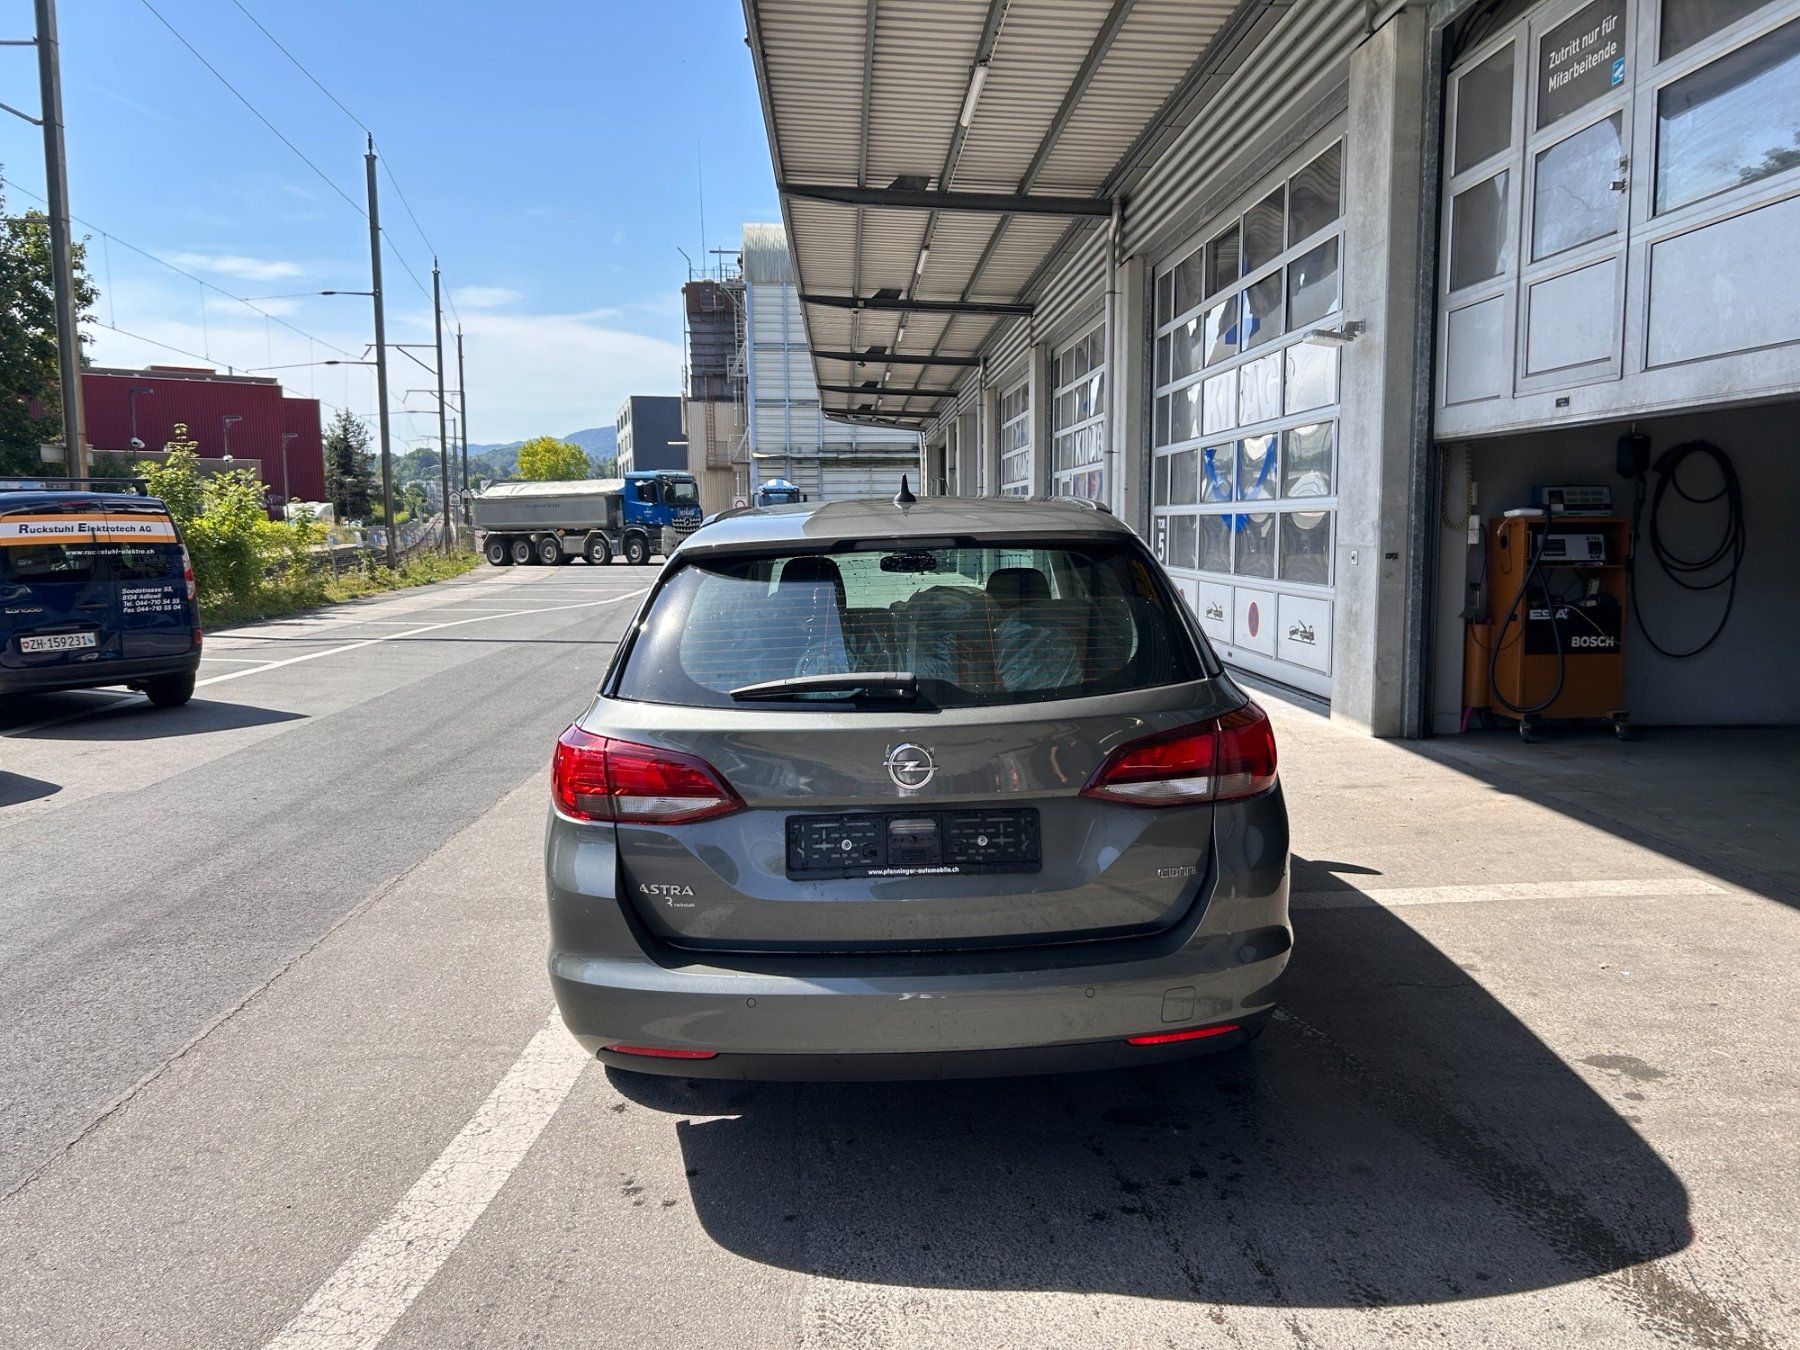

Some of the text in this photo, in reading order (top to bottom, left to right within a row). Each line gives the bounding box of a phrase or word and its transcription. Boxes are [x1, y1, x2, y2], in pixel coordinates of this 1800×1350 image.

[1549, 14, 1617, 69] Zutritt nur für
[1549, 40, 1617, 93] Mitarbeitende
[18, 522, 152, 534] Ruckstuhl Elektrotech AG
[65, 548, 155, 556] www.rucstuhl-elektro.ch
[1158, 532, 1165, 561] 5
[1571, 636, 1615, 648] BOSCH
[639, 883, 694, 896] ASTRA
